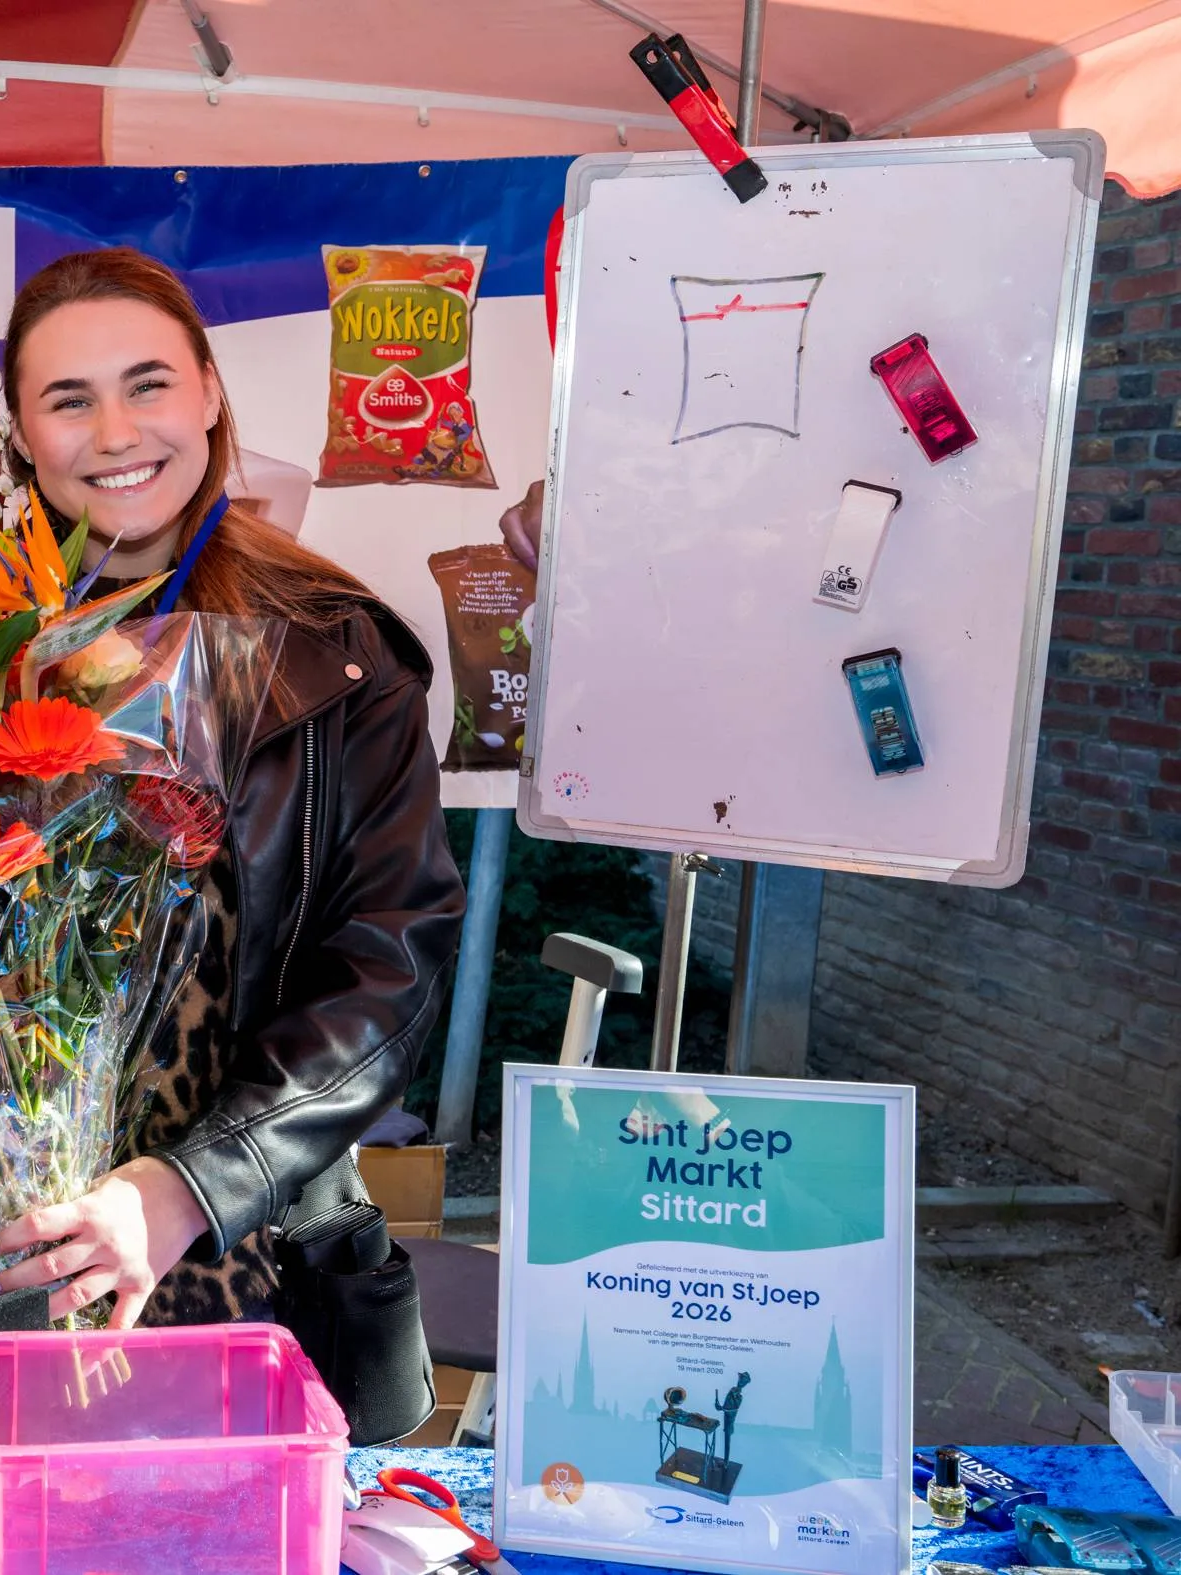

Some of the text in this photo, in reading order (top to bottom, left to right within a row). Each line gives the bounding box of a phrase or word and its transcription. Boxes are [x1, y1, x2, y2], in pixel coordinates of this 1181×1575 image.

[336, 296, 463, 345] Wokkels
[369, 391, 423, 408] Smiths
[489, 669, 529, 694] Bo
[501, 689, 528, 702] no
[619, 1115, 688, 1148] Sint
[646, 1156, 763, 1190] Markt
[640, 1191, 767, 1228] Sittard
[698, 1267, 708, 1275] de
[587, 1271, 820, 1310] Koning van St.Joep
[671, 1301, 732, 1323] 2026
[685, 1514, 744, 1527] Sittard-Geleen
